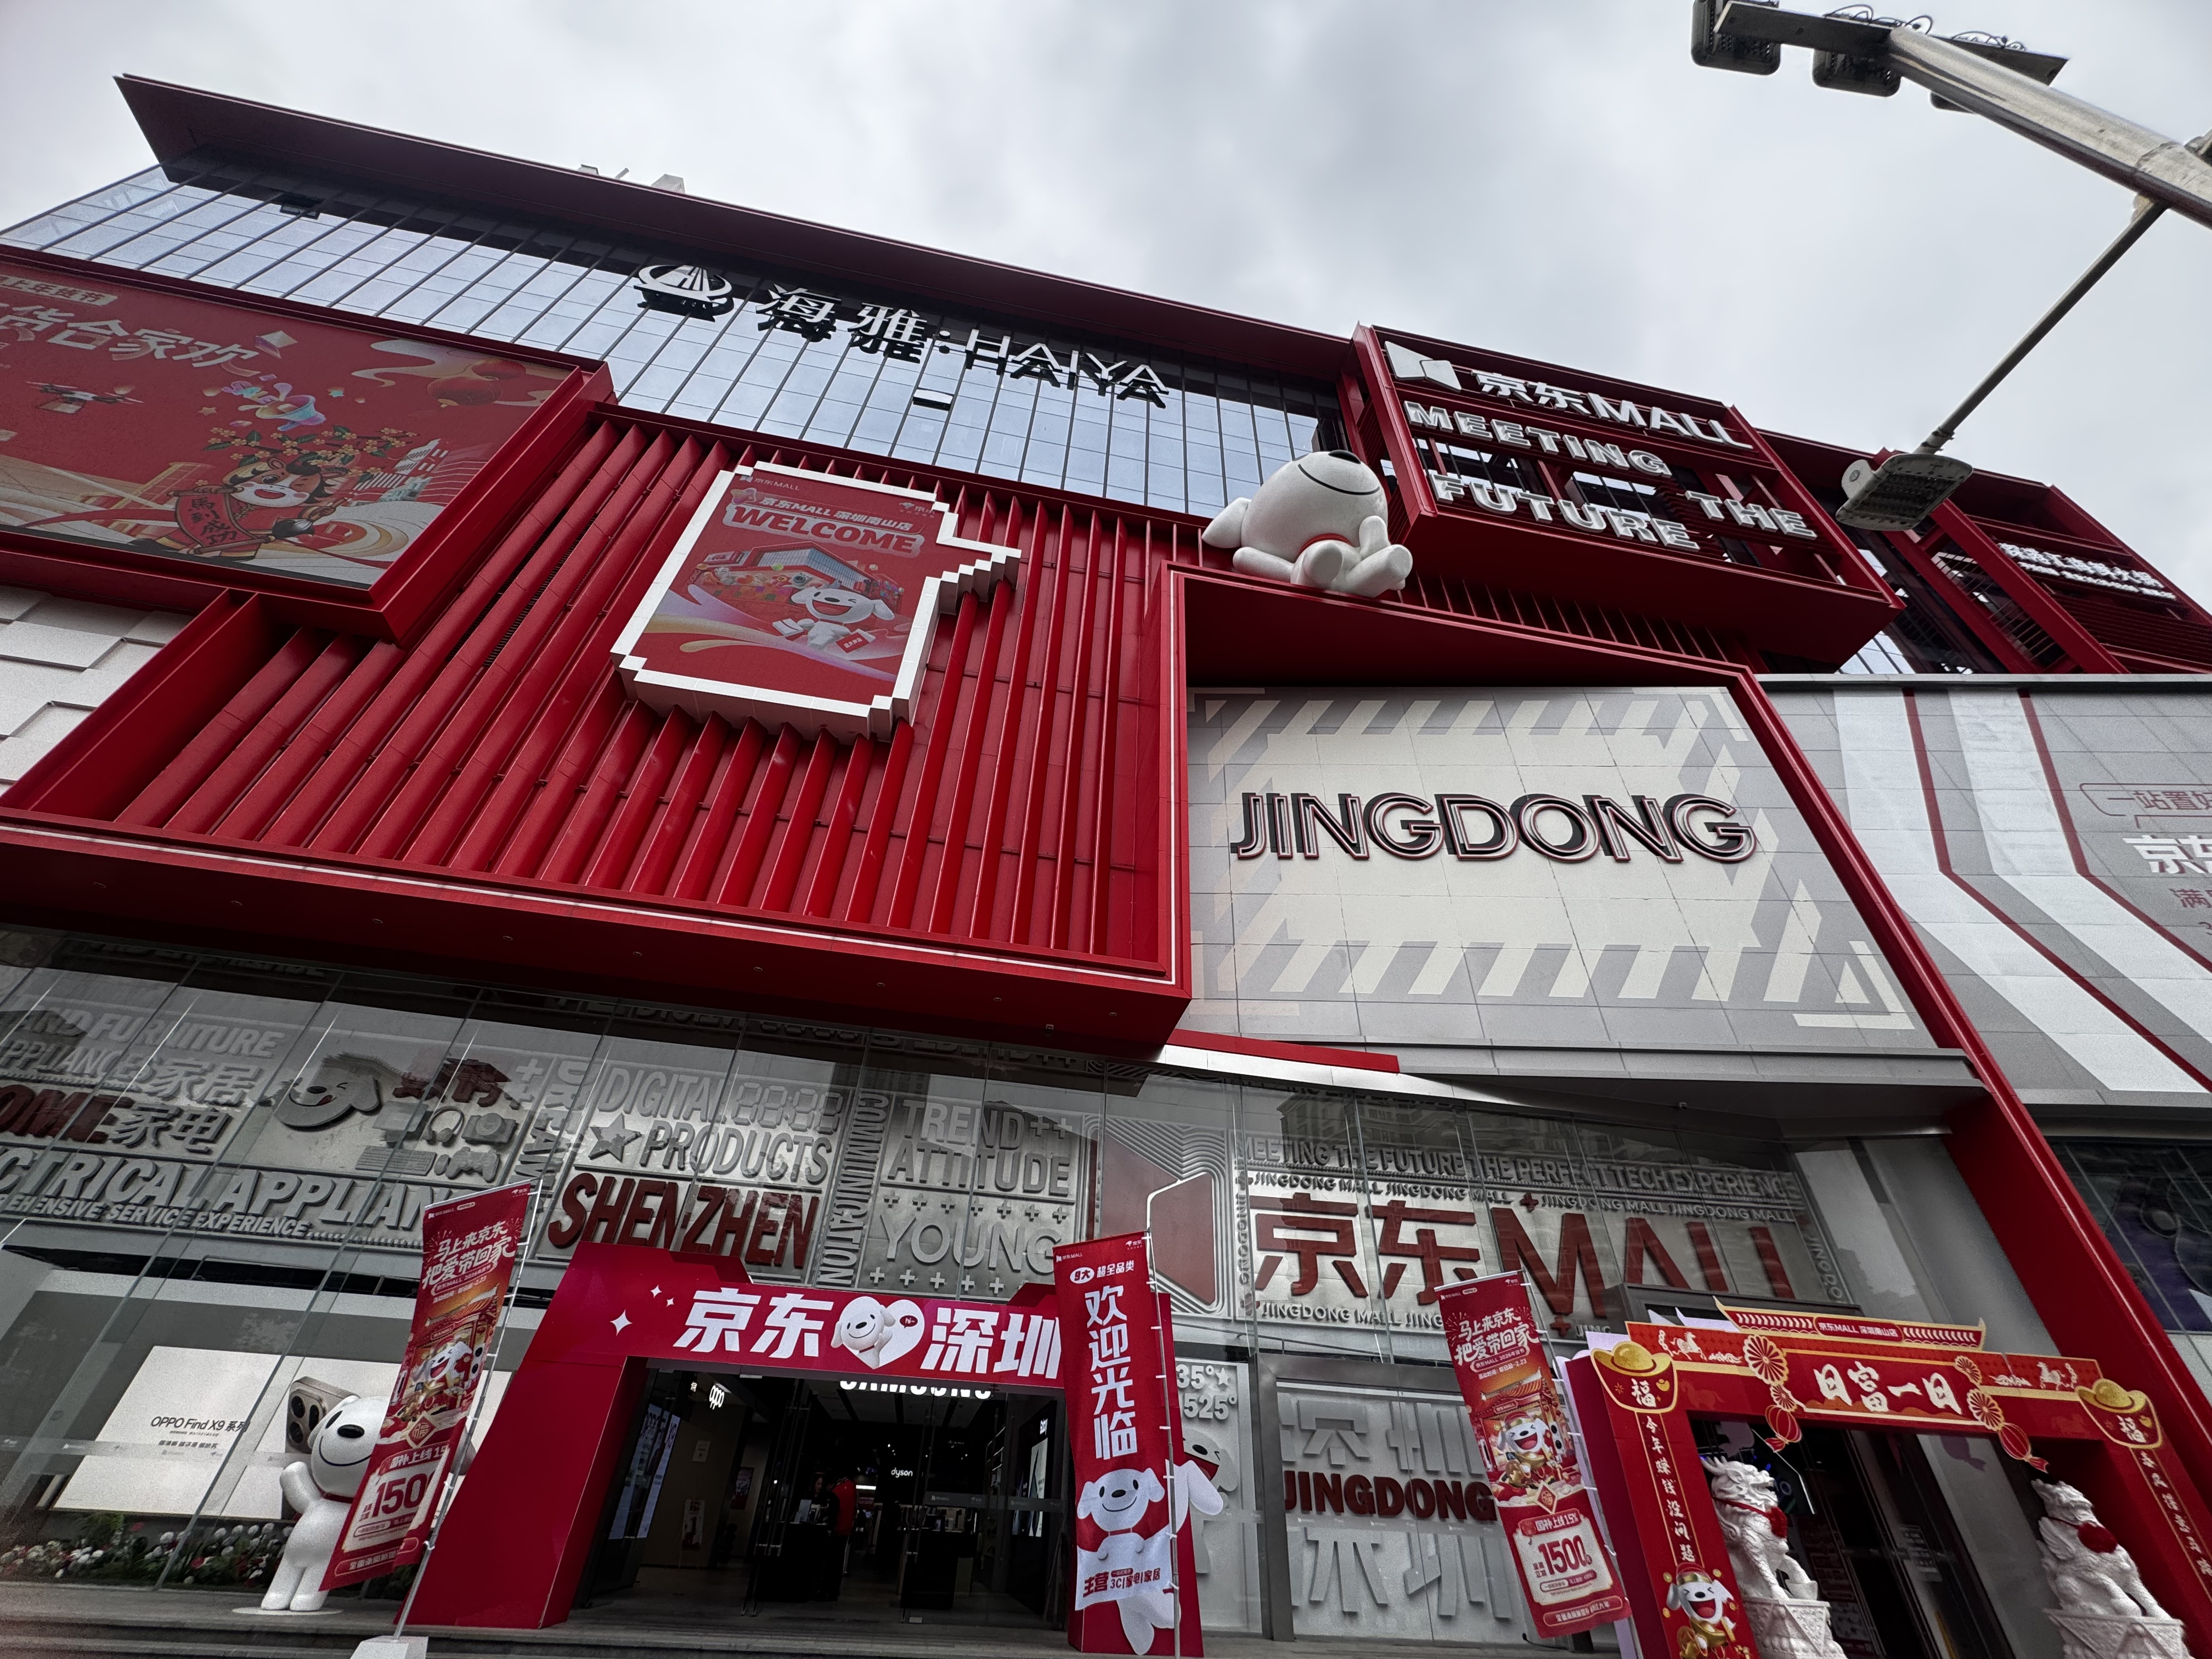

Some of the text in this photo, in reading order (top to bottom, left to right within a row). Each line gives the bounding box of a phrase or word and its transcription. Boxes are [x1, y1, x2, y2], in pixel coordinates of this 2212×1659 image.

[756, 283, 1169, 396] 海雅 HAIYA
[1471, 369, 1754, 450] 京东MALL
[1403, 400, 1818, 540] MEETING THE
[731, 506, 917, 553] WELCOME
[759, 496, 832, 516] 京东MALL
[834, 510, 913, 531] 深圳南山店
[1429, 469, 1700, 552] FUTURE
[1230, 792, 1757, 863] JINGDONG
[87, 1012, 286, 1058] FURNITURE
[0, 1038, 157, 1084] PPLIANCES
[139, 1057, 270, 1108] 家居
[0, 1084, 123, 1144] OME
[597, 1064, 724, 1124] DIGITAL
[111, 1105, 232, 1155] 家电
[903, 1098, 1025, 1150] TREND
[639, 1119, 833, 1185] PRODUCTS
[888, 1138, 1071, 1197] ATTITUDE
[1242, 1133, 1805, 1203] MEETING THE FUTURE THE PERFECT TECH EXPERIENCE
[0, 1146, 454, 1232] CTRICAL APPLIAN
[817, 1096, 889, 1286] COMMUNICATION
[1253, 1172, 1513, 1205] JINGDONG MALL JINGDONG MALL
[1541, 1194, 1797, 1223] JINGDONG MALL JINGDONG MALL
[109, 1202, 193, 1228] SERVICE
[194, 1211, 311, 1238] EXPERIENCE
[433, 1220, 509, 1262] 马上来京东
[548, 1172, 820, 1270] SHENZHEN
[879, 1211, 1063, 1275] YOUNG
[422, 1235, 516, 1289] 把爱带回家
[1074, 1260, 1135, 1282] 9大 超全品类
[1803, 1235, 1844, 1304] JINGDO
[672, 1286, 1062, 1381] 京东 深圳
[1262, 1301, 1444, 1330] JINGDONG MALL JING
[1458, 1306, 1522, 1342] 马上来京东
[1818, 1322, 1860, 1334] 京东MALL
[1454, 1322, 1540, 1366] 把爱带回家
[1085, 1285, 1138, 1460] 欢迎光临
[1631, 1378, 1656, 1408] 福
[151, 1416, 184, 1428] OPPO
[183, 1419, 210, 1430] Find
[207, 1420, 225, 1431] X9
[2116, 1414, 2147, 1444] 福
[890, 1467, 914, 1479] dyson
[1284, 1470, 1498, 1521] JINGDONG
[1645, 1415, 1696, 1563] 今年赚钱没问题
[1537, 1534, 1587, 1576] 1500
[1083, 1571, 1109, 1598] 主营
